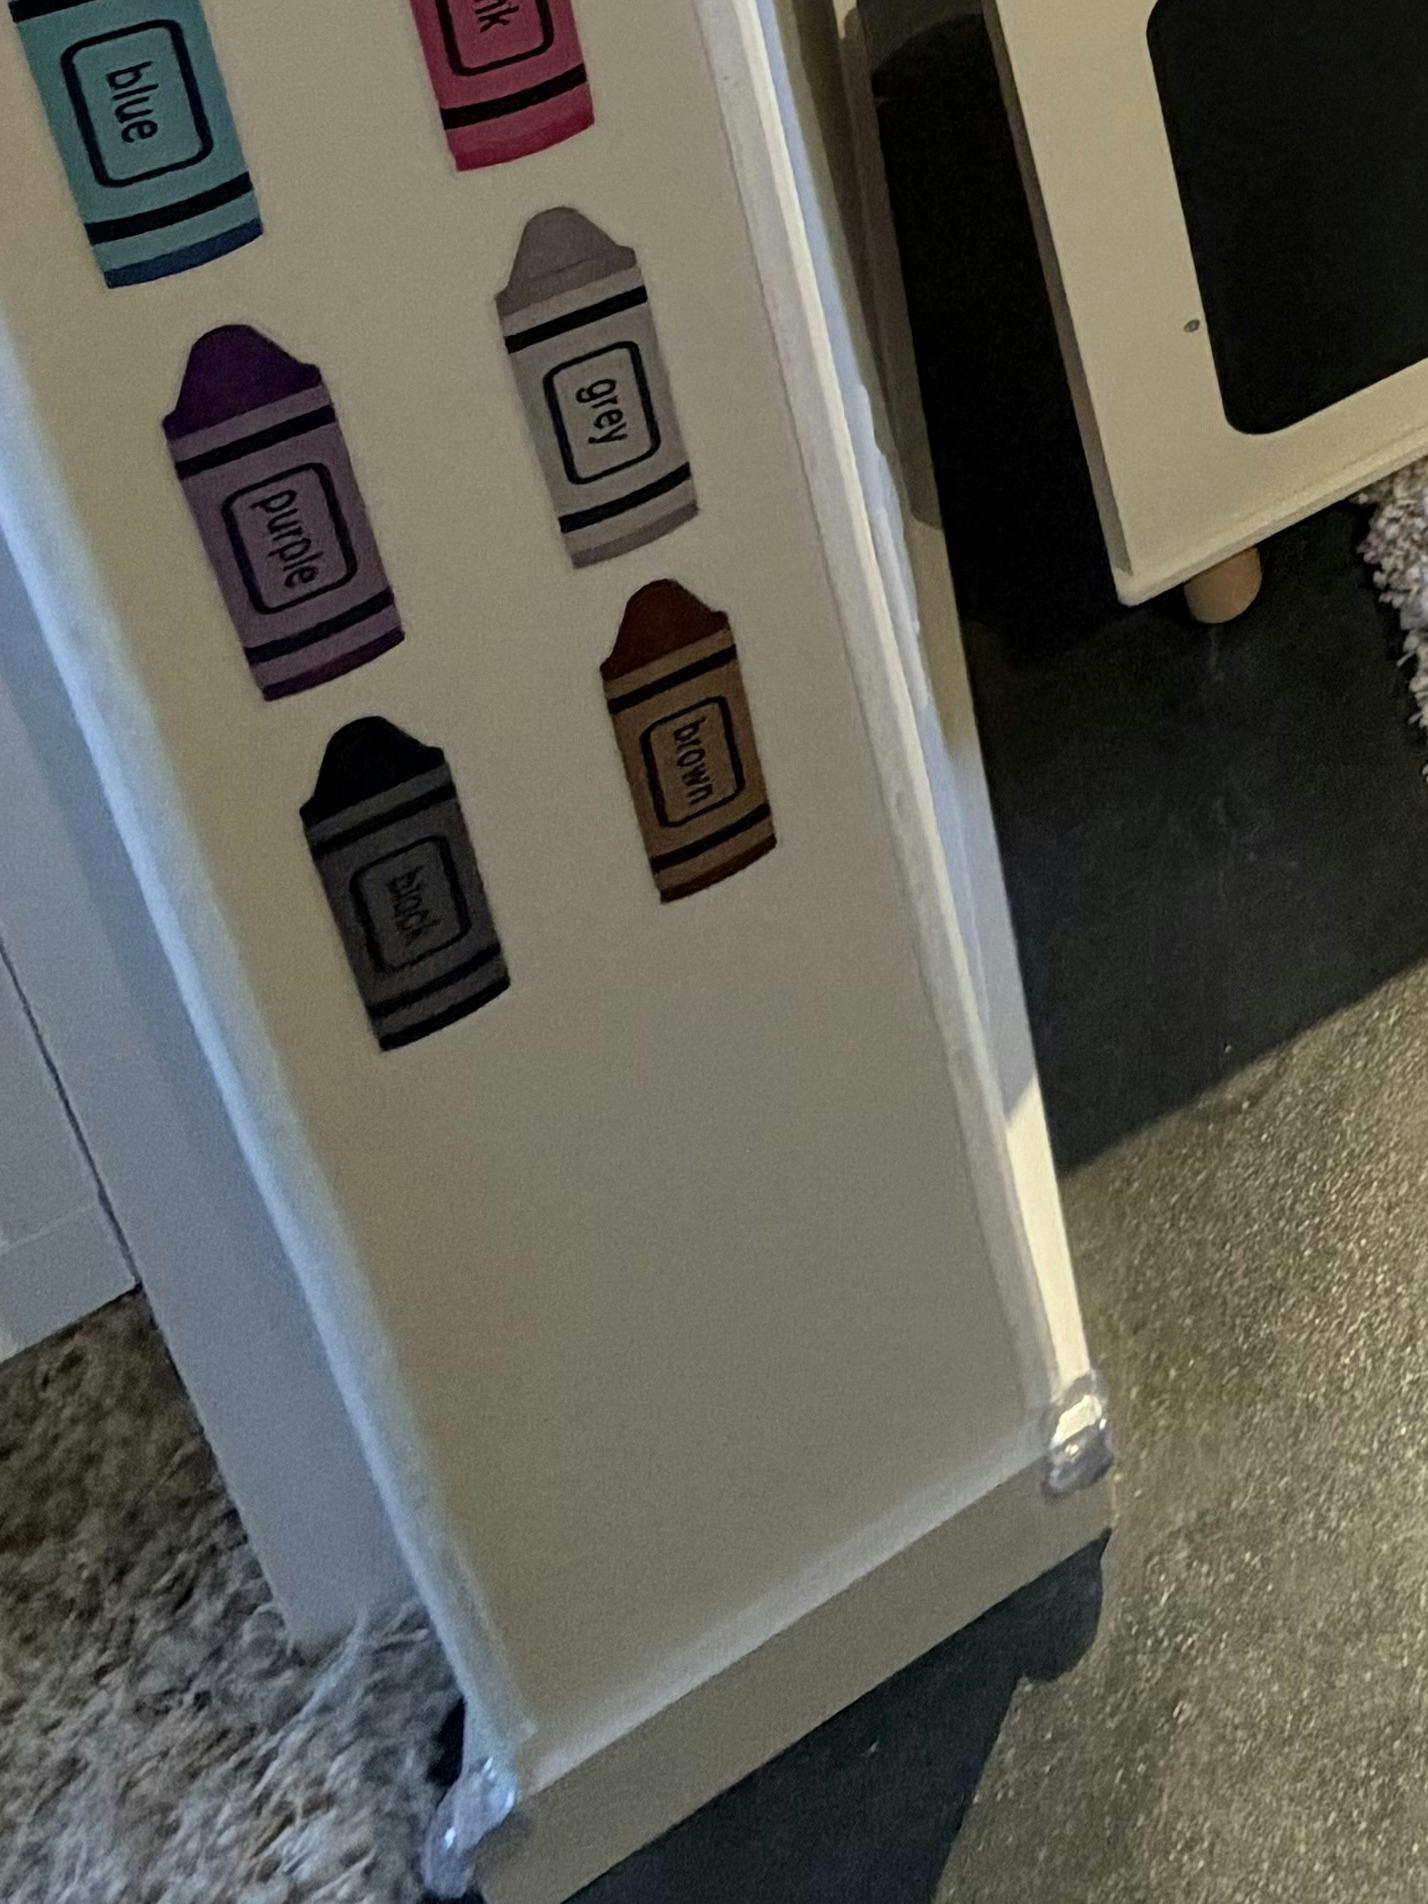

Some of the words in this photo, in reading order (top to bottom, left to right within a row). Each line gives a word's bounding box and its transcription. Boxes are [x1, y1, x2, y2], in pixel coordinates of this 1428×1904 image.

[106, 61, 160, 143] blue
[576, 379, 629, 444] grey
[249, 489, 320, 589] purple
[672, 719, 714, 805] brown
[385, 866, 442, 946] black
